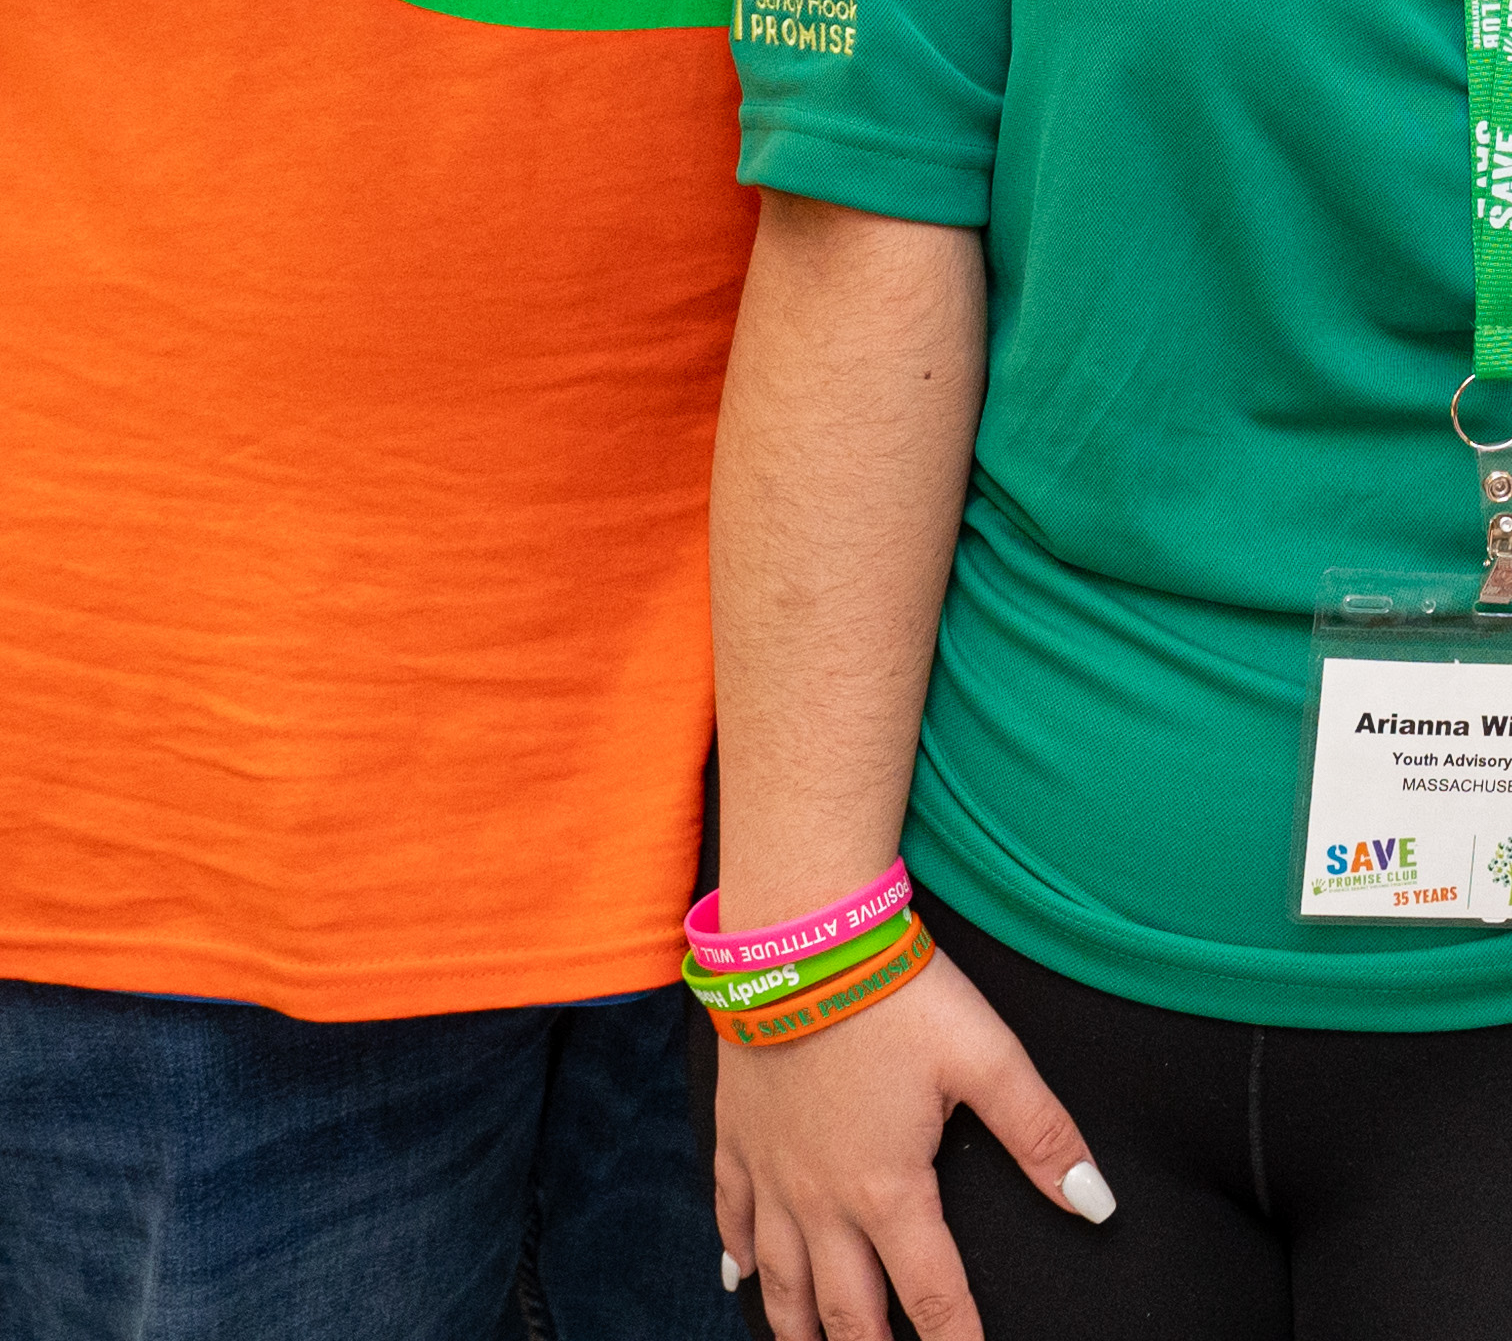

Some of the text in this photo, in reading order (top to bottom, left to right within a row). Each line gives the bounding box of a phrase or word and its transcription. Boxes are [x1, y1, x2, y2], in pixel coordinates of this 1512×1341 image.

[750, 13, 857, 57] PROMISE
[1354, 712, 1470, 736] Arianna
[1392, 752, 1439, 767] Youth
[1443, 753, 1512, 771] Advisory
[1326, 837, 1418, 876] SAVE
[1328, 873, 1382, 888] PROMISE
[1386, 869, 1418, 882] CLUB
[1393, 890, 1410, 906] 35
[1413, 886, 1458, 904] YEARS
[699, 946, 736, 964] WILL
[741, 918, 838, 963] ATTITUDE
[727, 963, 800, 1006] Sandy
[757, 1007, 815, 1038] SAVE
[816, 951, 914, 1018] PROMISE
